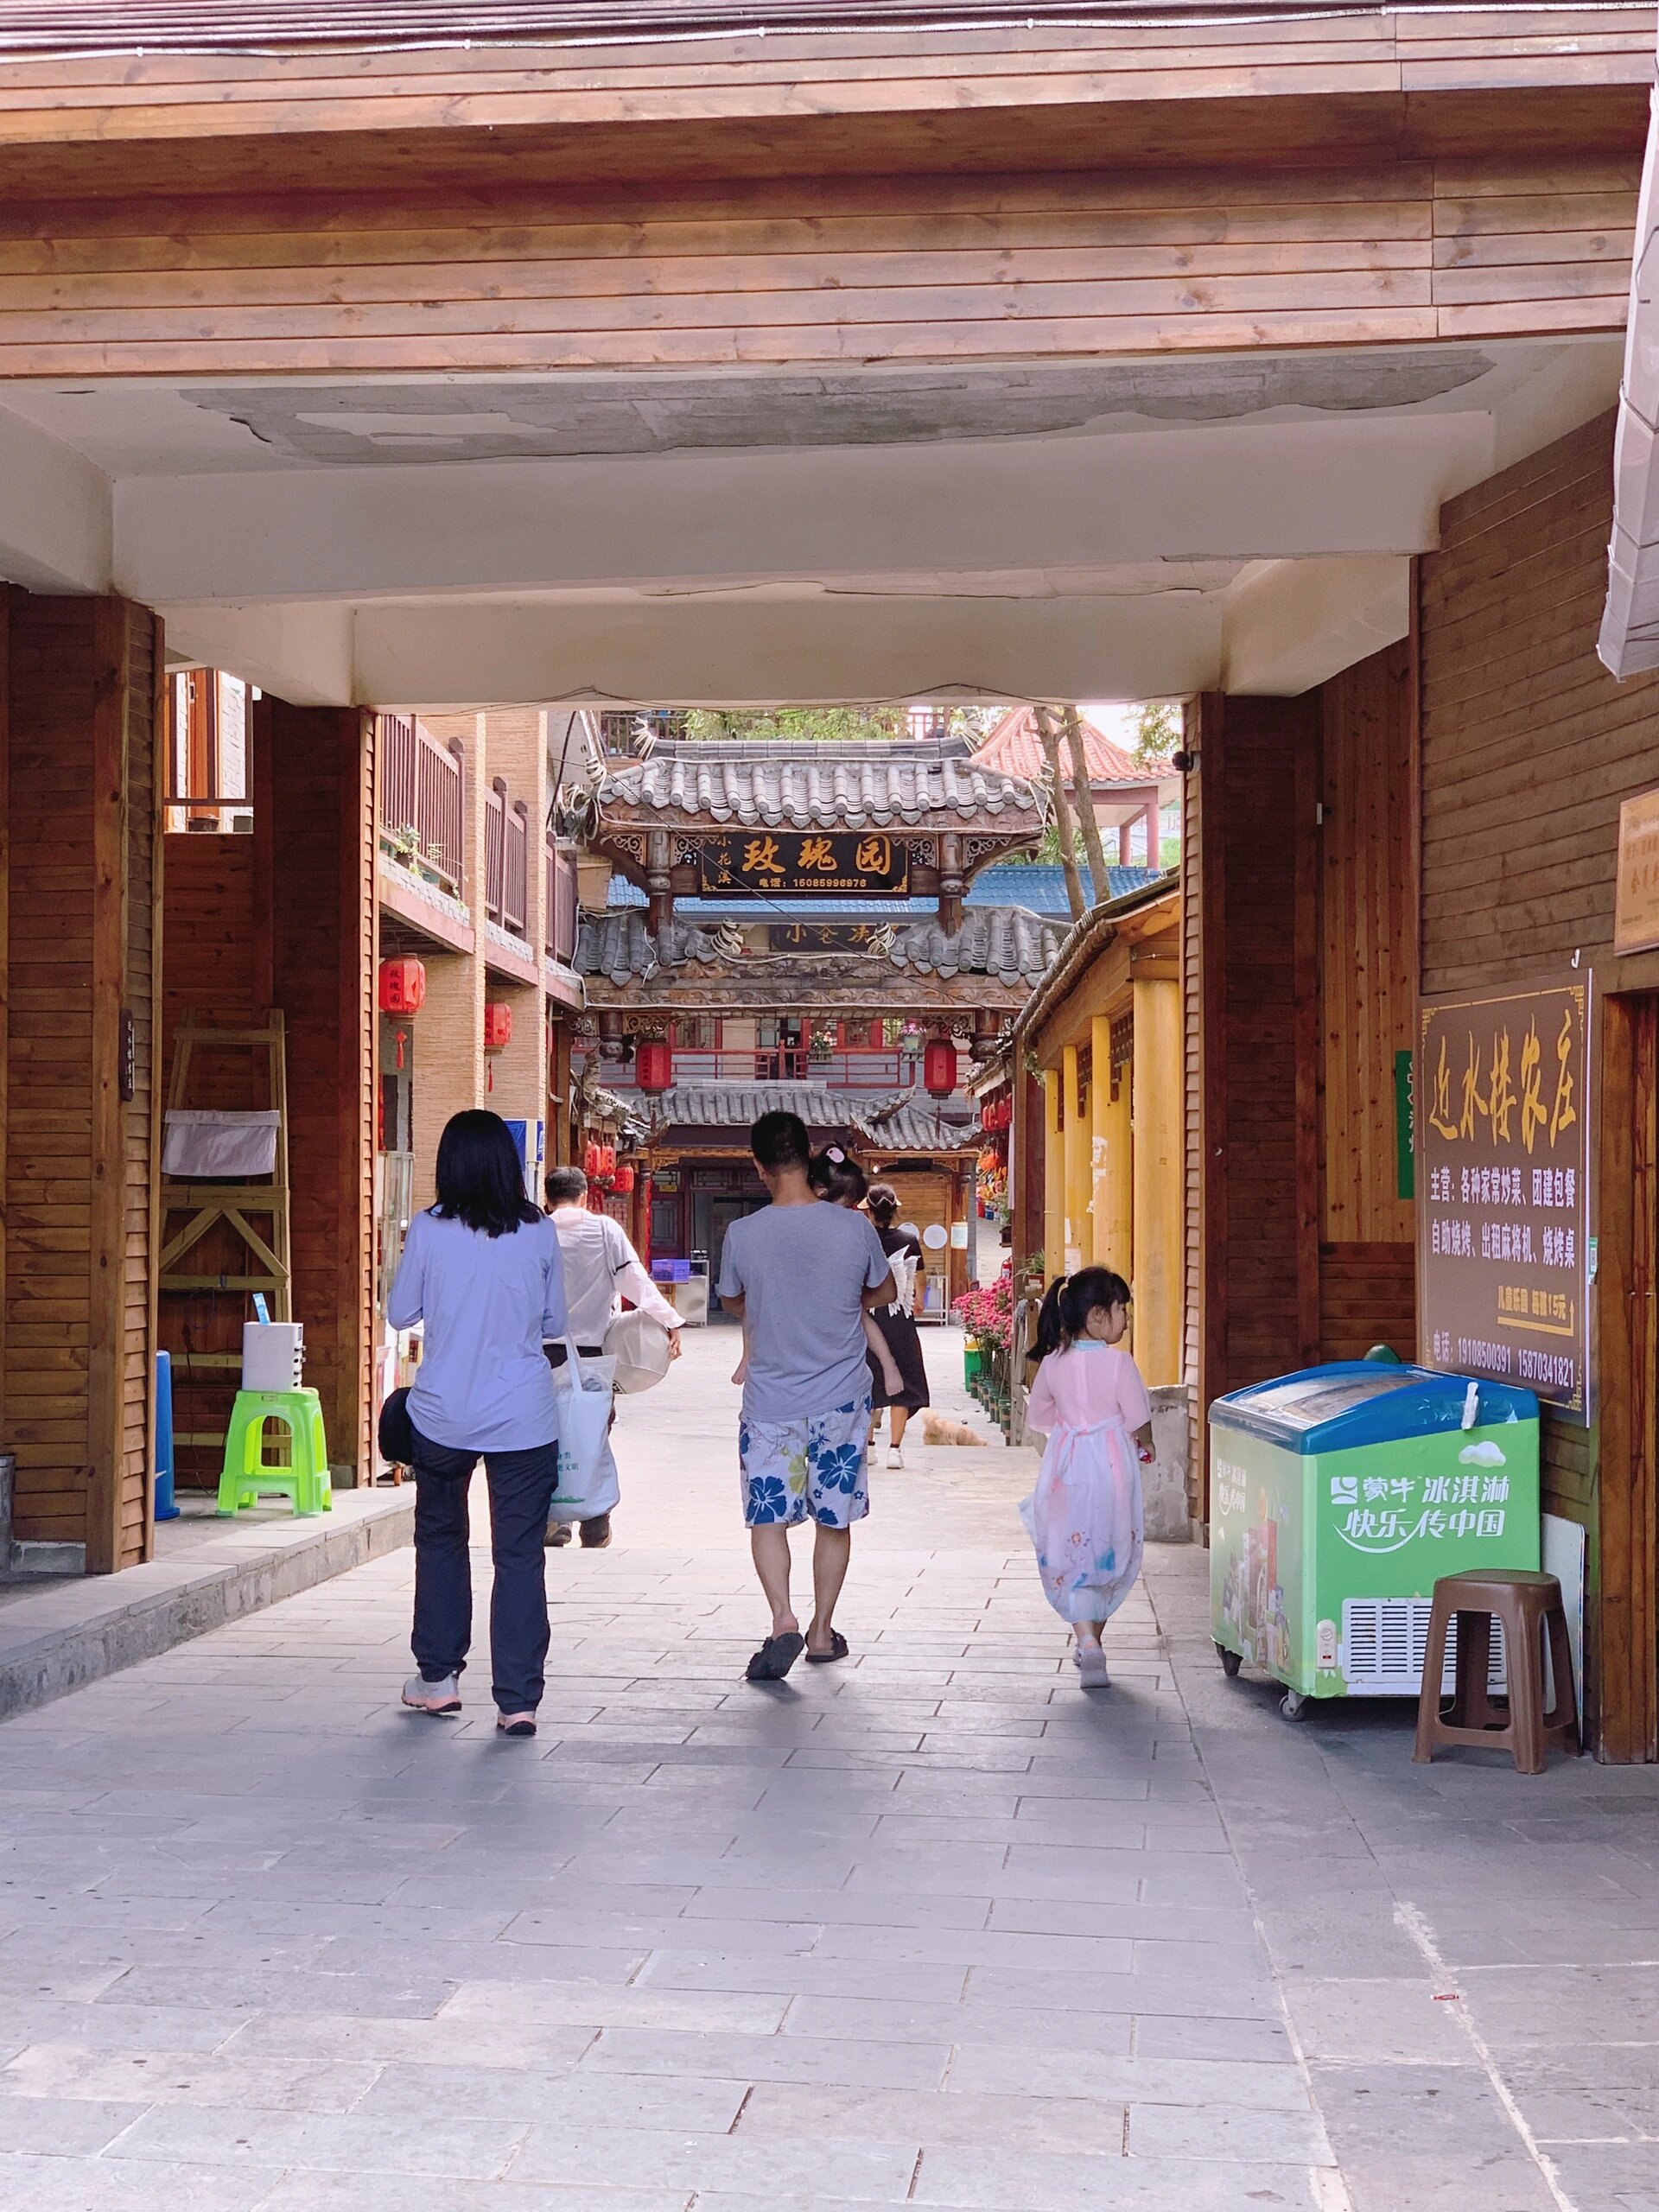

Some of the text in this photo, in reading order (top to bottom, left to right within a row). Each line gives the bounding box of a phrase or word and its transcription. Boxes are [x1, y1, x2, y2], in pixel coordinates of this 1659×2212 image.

[741, 835, 891, 875] 玫瑰园
[1518, 1349, 1574, 1388] 15870341821
[1363, 1476, 1510, 1503] 蒙牛 冰淇淋
[1342, 1509, 1505, 1539] 快乐传中国
